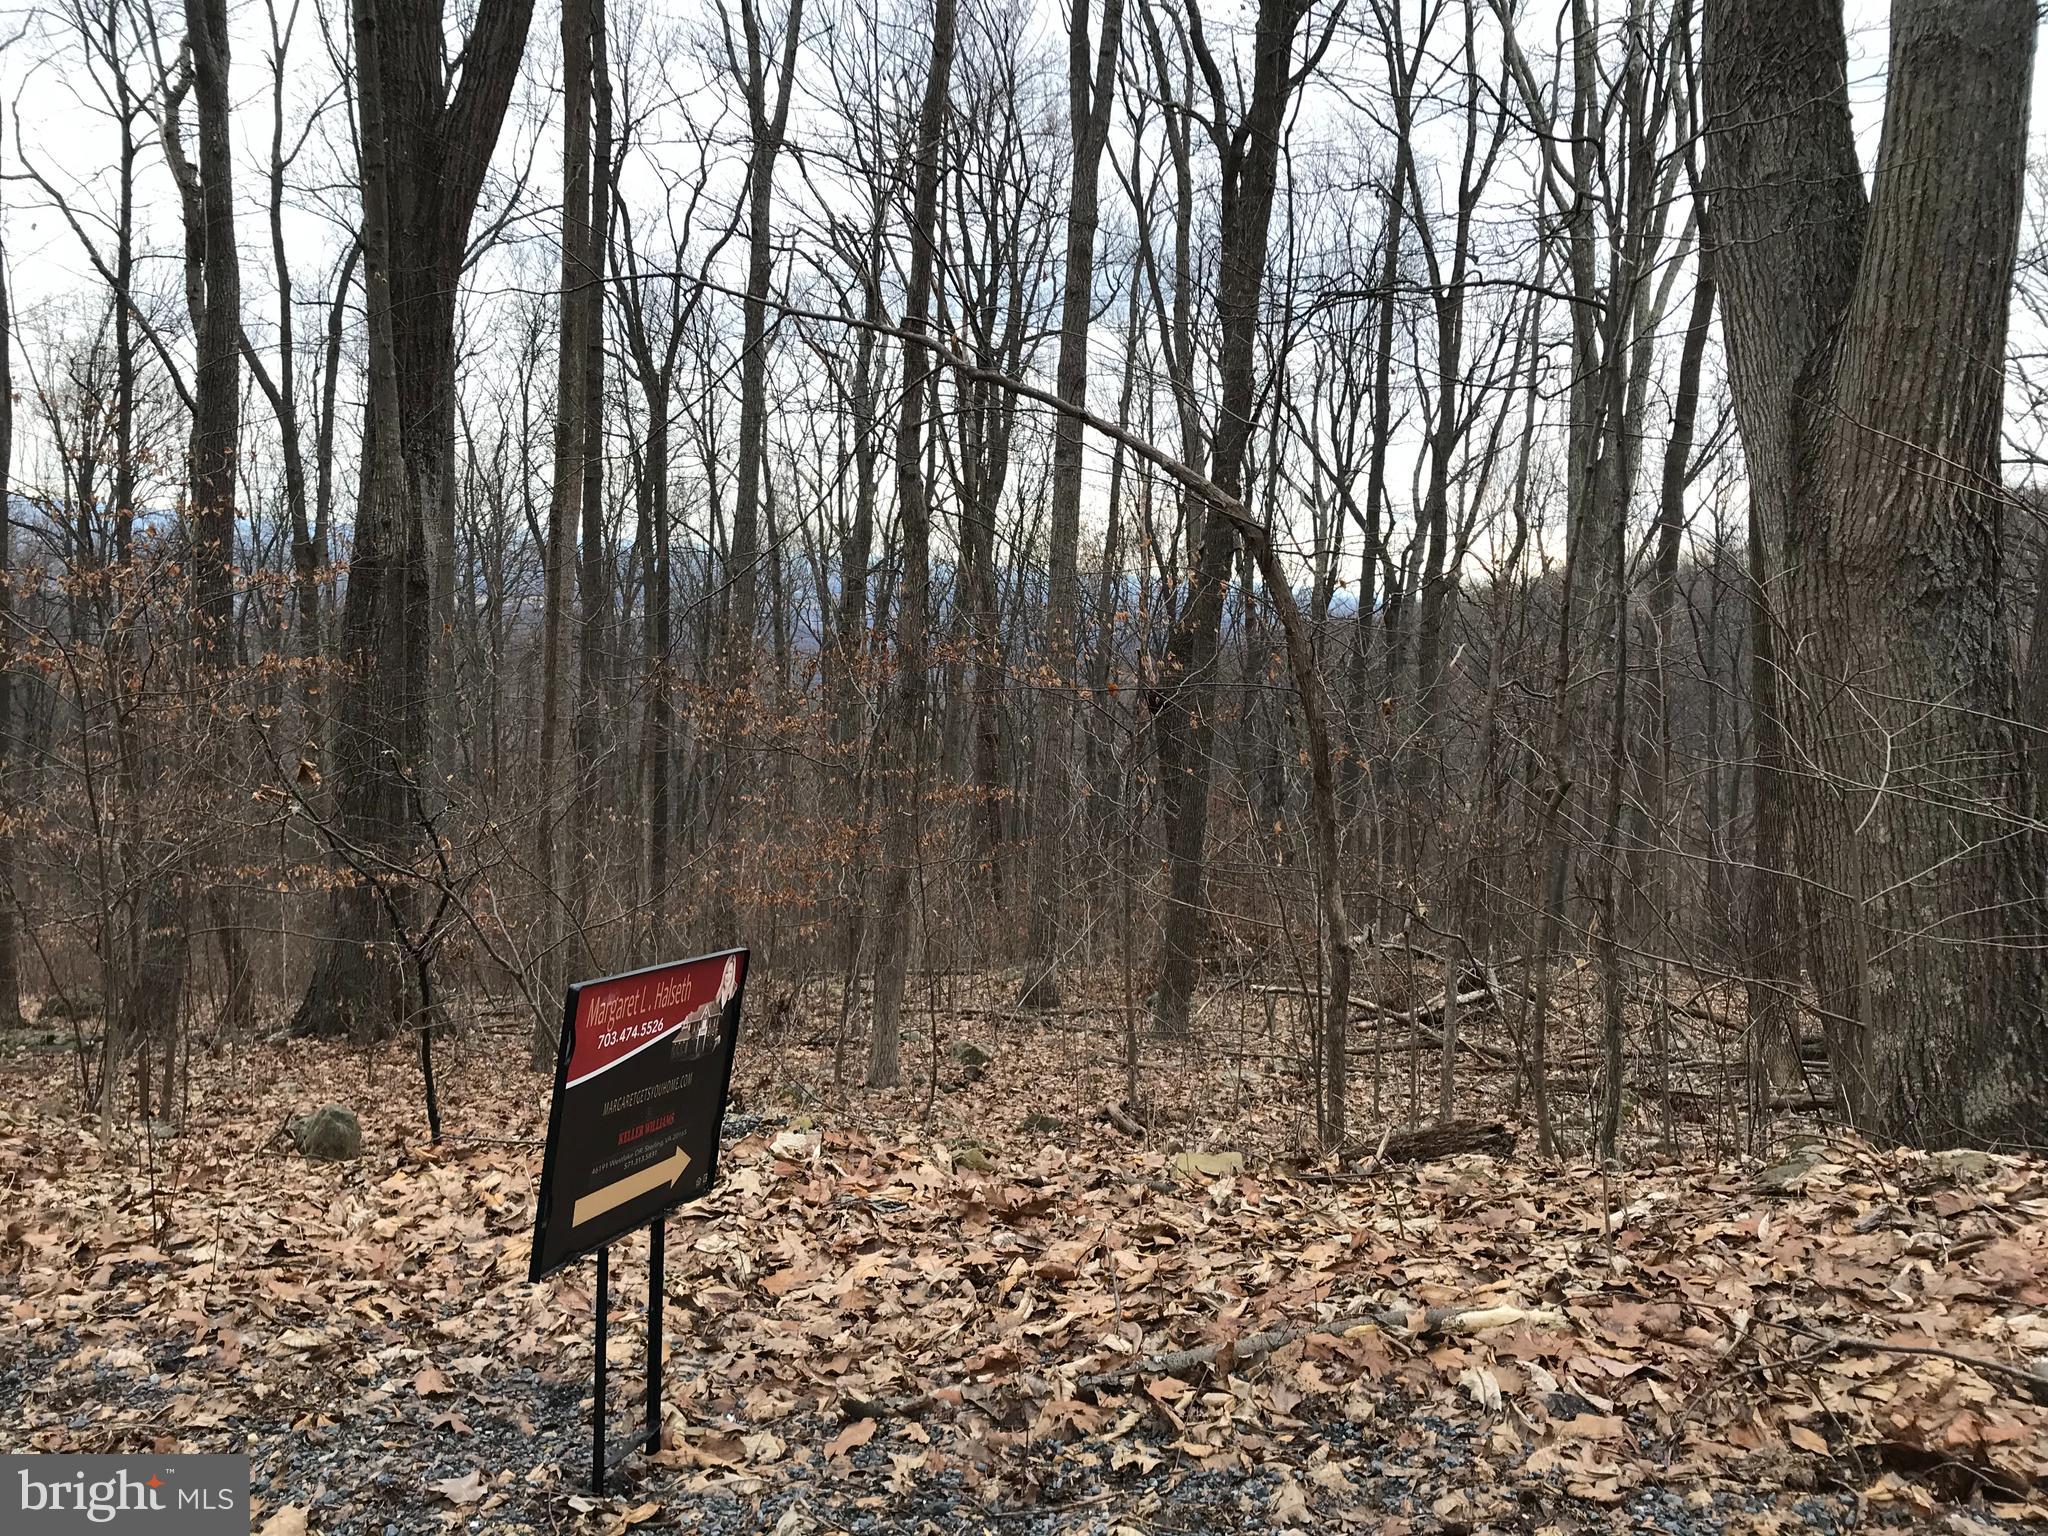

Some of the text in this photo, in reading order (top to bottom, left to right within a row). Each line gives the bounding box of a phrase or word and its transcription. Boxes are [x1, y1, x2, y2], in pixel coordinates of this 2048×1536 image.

[585, 992, 641, 1032] Margaret
[653, 973, 692, 1011] Halseth
[598, 1018, 664, 1050] 703.474.5526
[617, 1113, 675, 1145] KELLER WILLIAMS
